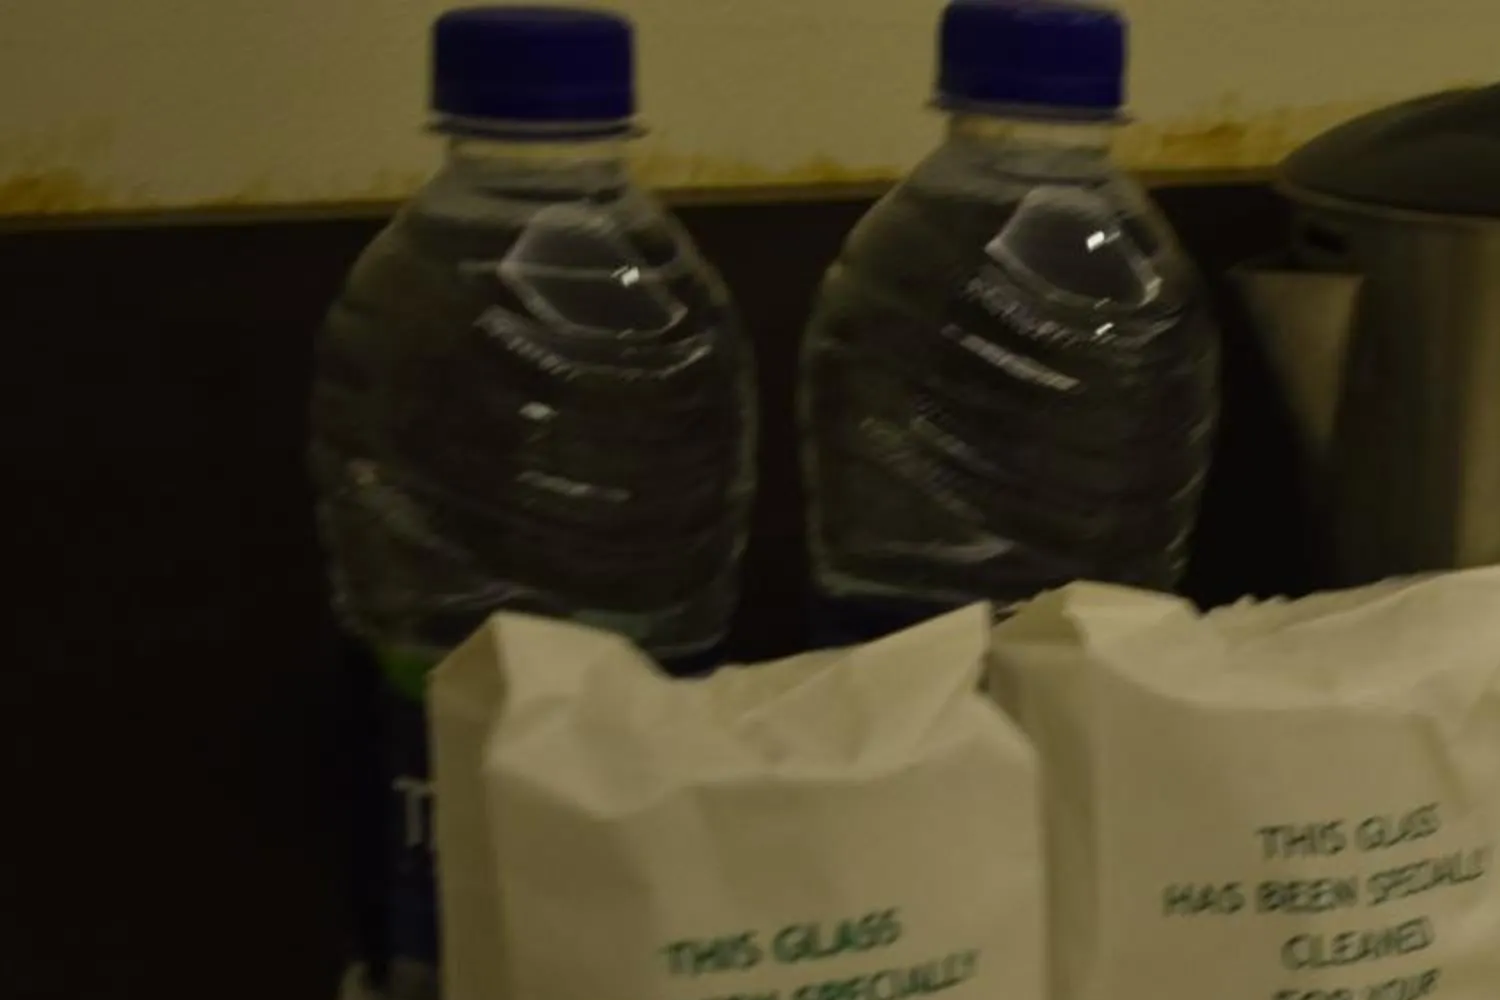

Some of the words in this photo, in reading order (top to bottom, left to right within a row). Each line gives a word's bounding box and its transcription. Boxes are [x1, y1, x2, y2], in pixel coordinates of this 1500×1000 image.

[1255, 820, 1347, 860] THIS
[1162, 882, 1245, 915] HAS
[1254, 876, 1359, 914] BEEN
[662, 931, 761, 975] THIS
[772, 908, 902, 964] GLASS
